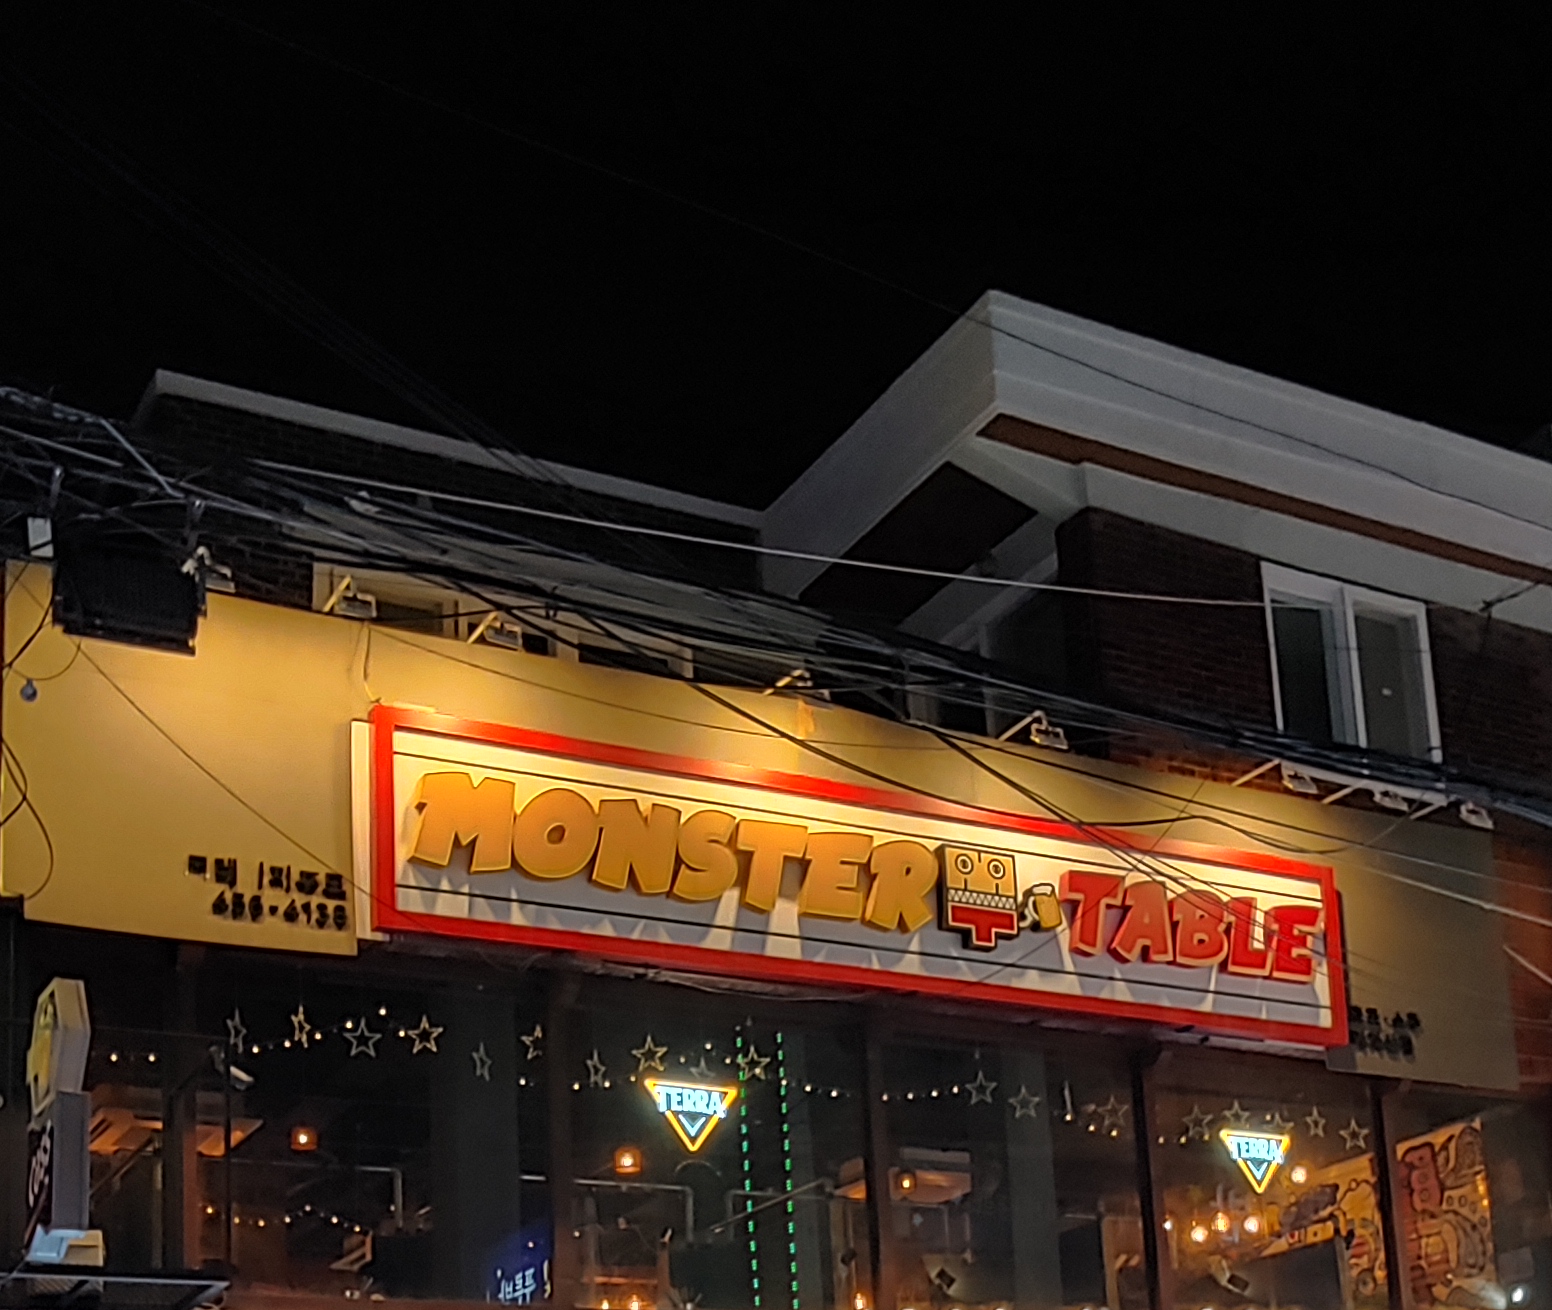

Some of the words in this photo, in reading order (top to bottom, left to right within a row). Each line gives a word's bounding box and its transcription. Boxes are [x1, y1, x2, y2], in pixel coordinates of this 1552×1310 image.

[408, 771, 940, 936] MONSTER
[1059, 869, 1328, 985] TABLE
[654, 1083, 726, 1117] TERRA
[1228, 1135, 1285, 1164] TERRA
